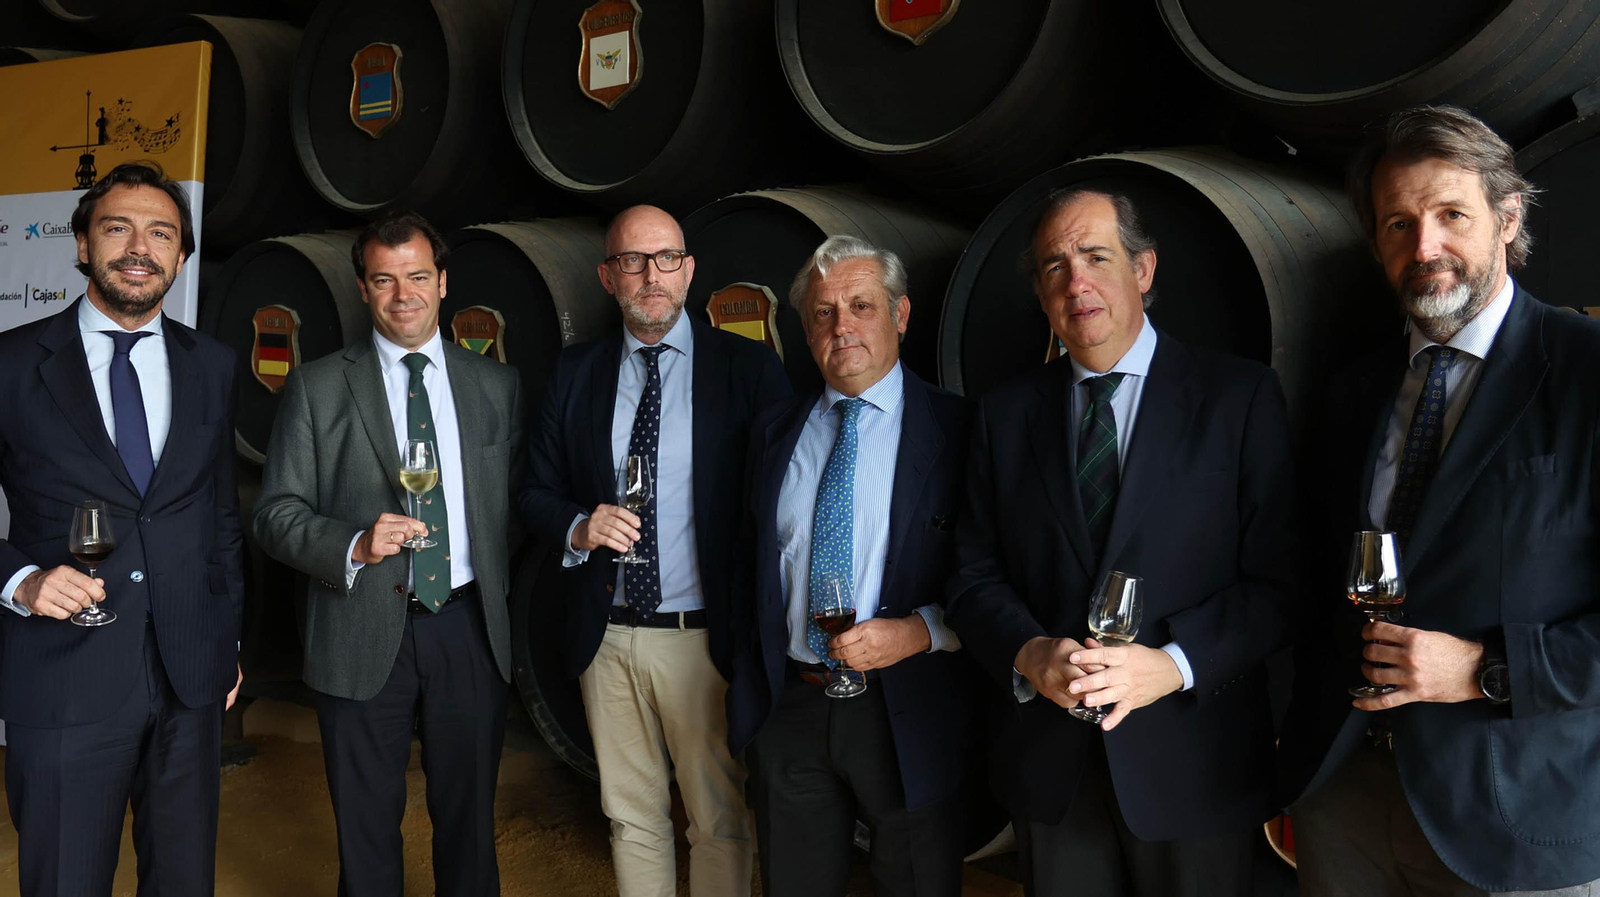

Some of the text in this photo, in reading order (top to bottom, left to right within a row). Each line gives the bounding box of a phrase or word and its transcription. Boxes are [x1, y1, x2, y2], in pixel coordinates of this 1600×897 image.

[0, 287, 66, 304] dación Cajasol
[721, 300, 760, 315] COLOMBIA
